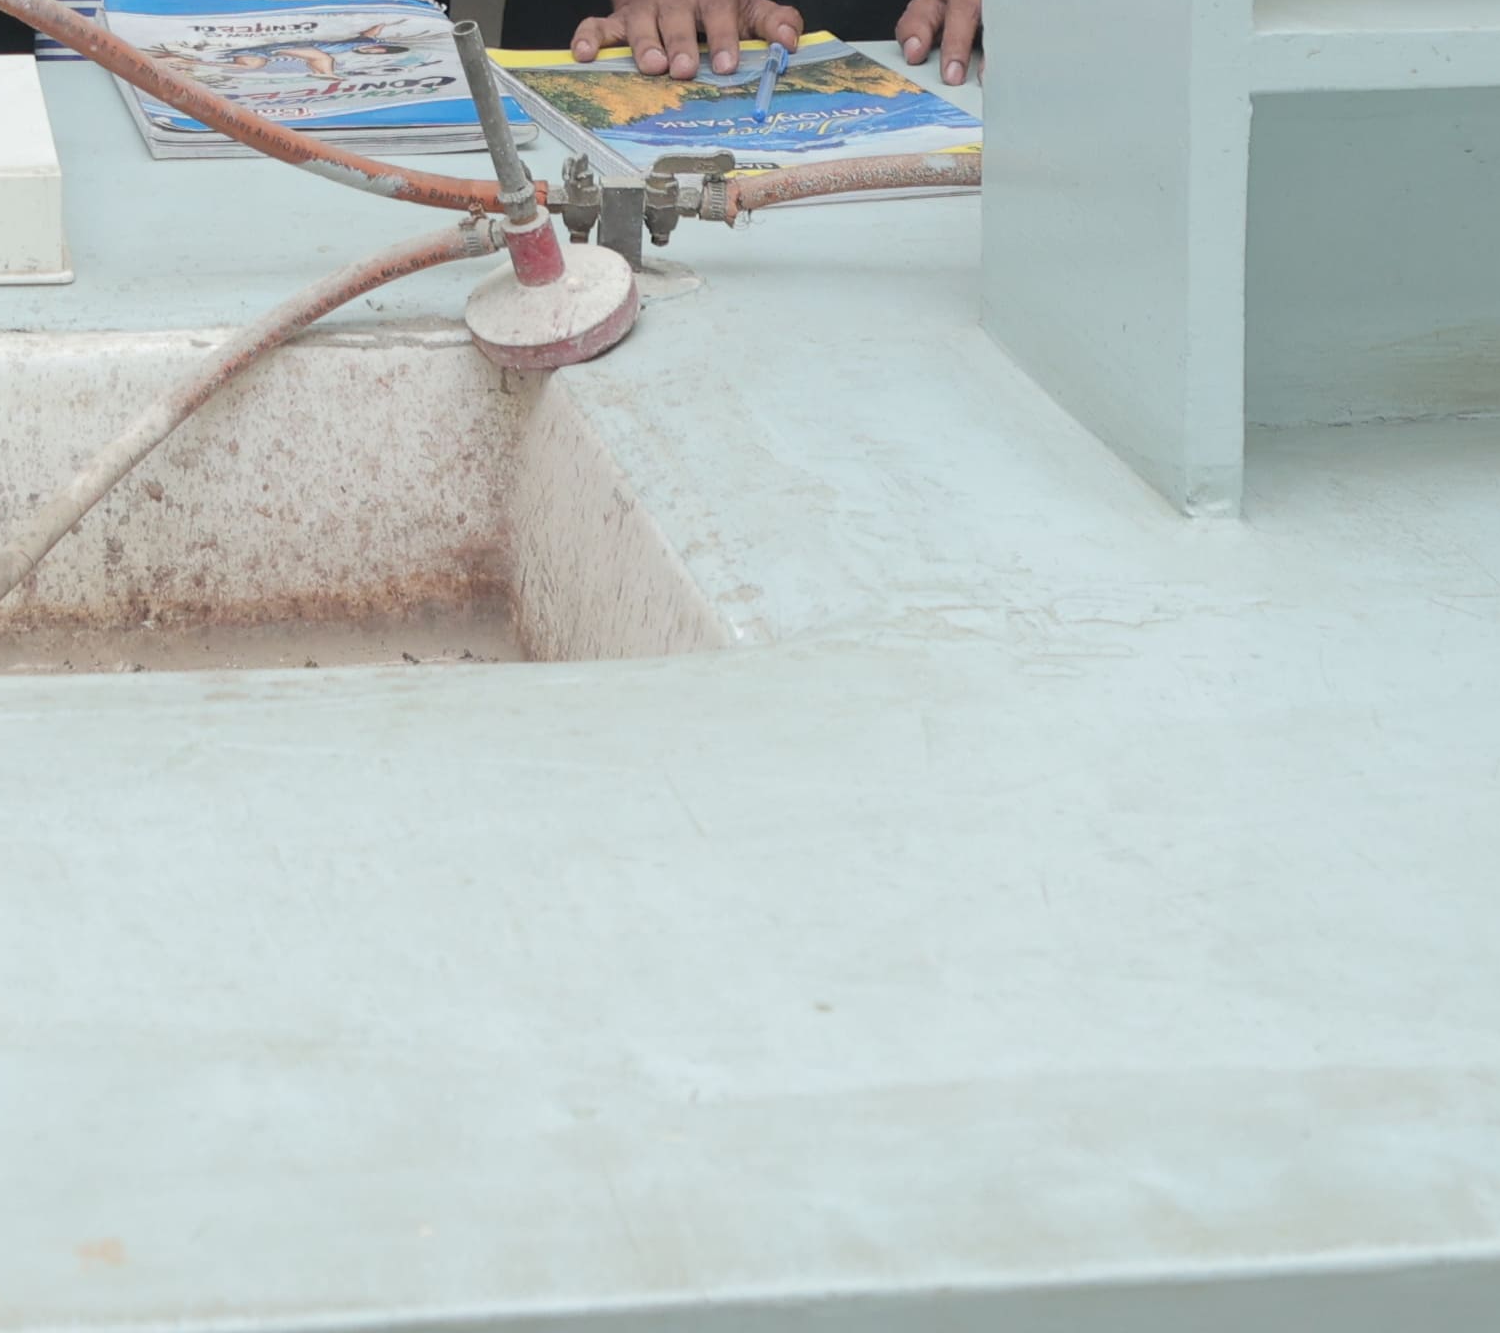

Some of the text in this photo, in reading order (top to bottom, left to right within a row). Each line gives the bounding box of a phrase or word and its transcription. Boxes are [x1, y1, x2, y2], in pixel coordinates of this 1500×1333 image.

[223, 75, 457, 100] CONMEBO
[655, 118, 735, 129] PARK
[727, 112, 832, 135] Jasper
[429, 188, 463, 204] Batch
